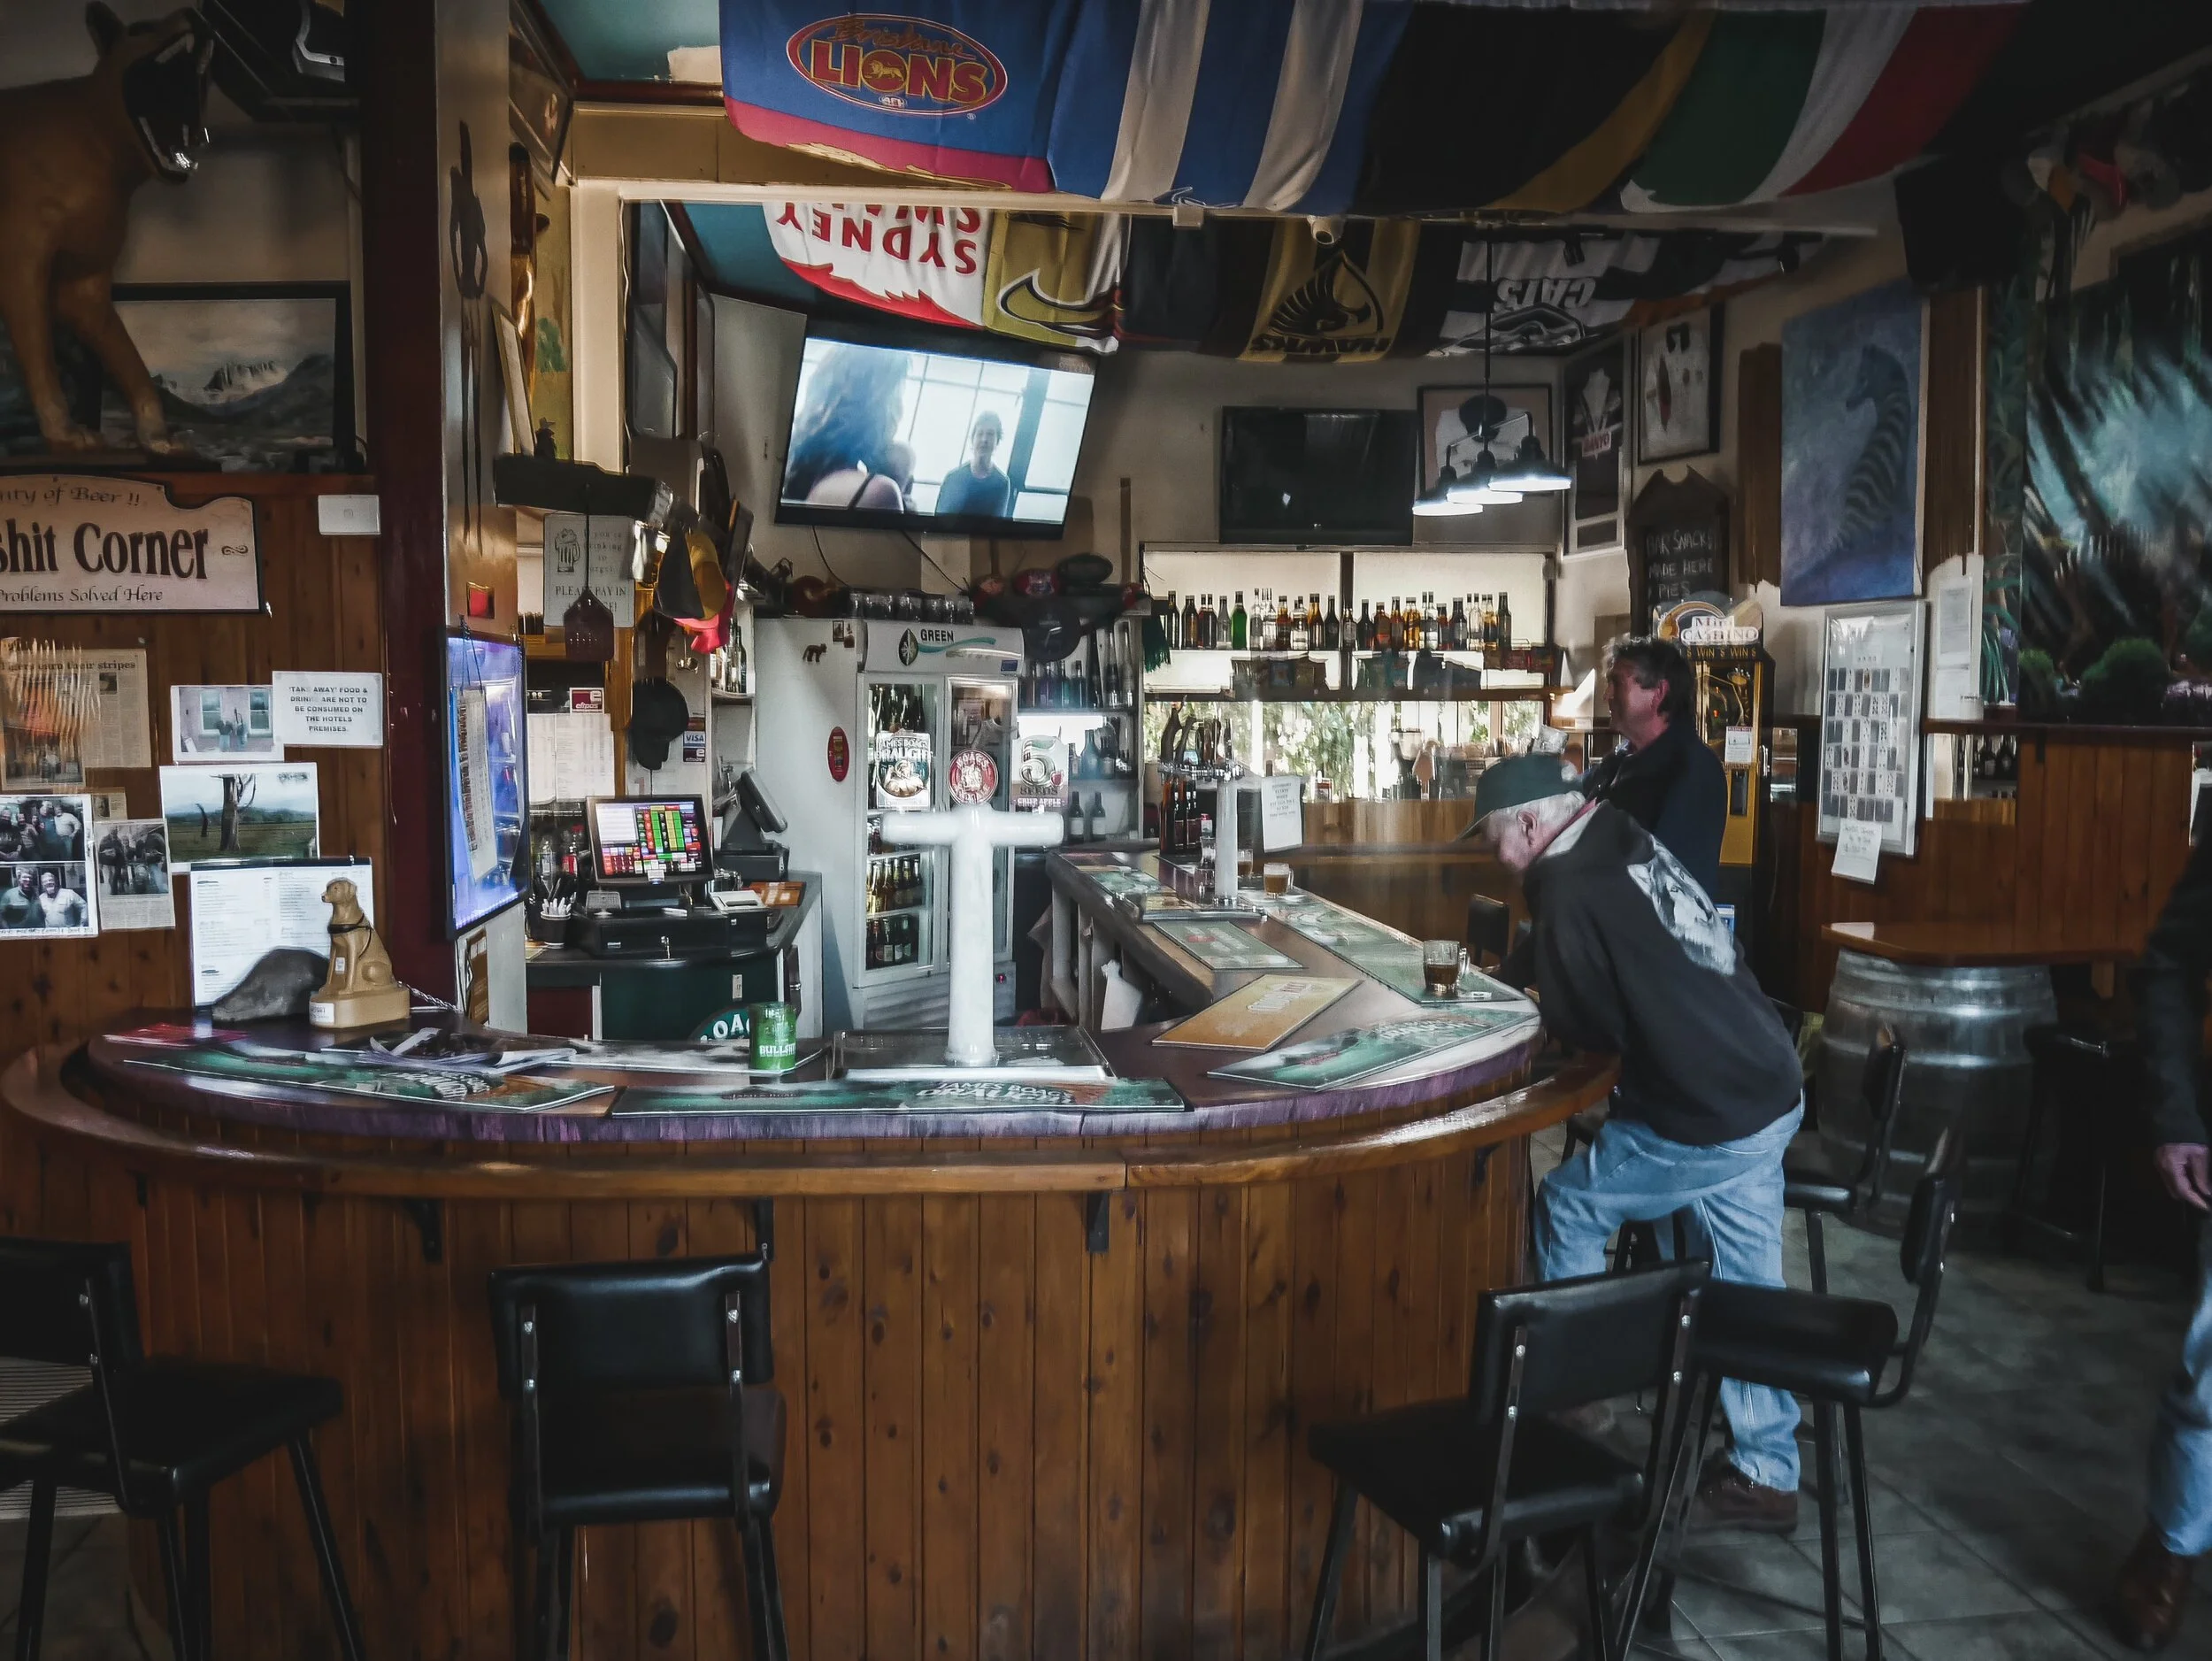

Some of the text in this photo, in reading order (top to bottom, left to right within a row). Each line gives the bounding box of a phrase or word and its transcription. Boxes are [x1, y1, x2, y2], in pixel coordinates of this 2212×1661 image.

[827, 17, 978, 60] Brisbane
[810, 39, 988, 104] LIONS
[775, 202, 978, 275] SYDNEY
[44, 486, 65, 506] of
[71, 487, 121, 503] Beer
[73, 522, 209, 579] Corner
[69, 586, 119, 602] Solved
[124, 584, 163, 601] Here
[556, 586, 592, 596] PLEA
[616, 587, 626, 596] IN
[920, 628, 955, 642] GREEN
[1696, 647, 1716, 657] WIN
[1730, 648, 1749, 658] WIN
[97, 660, 135, 671] stripes
